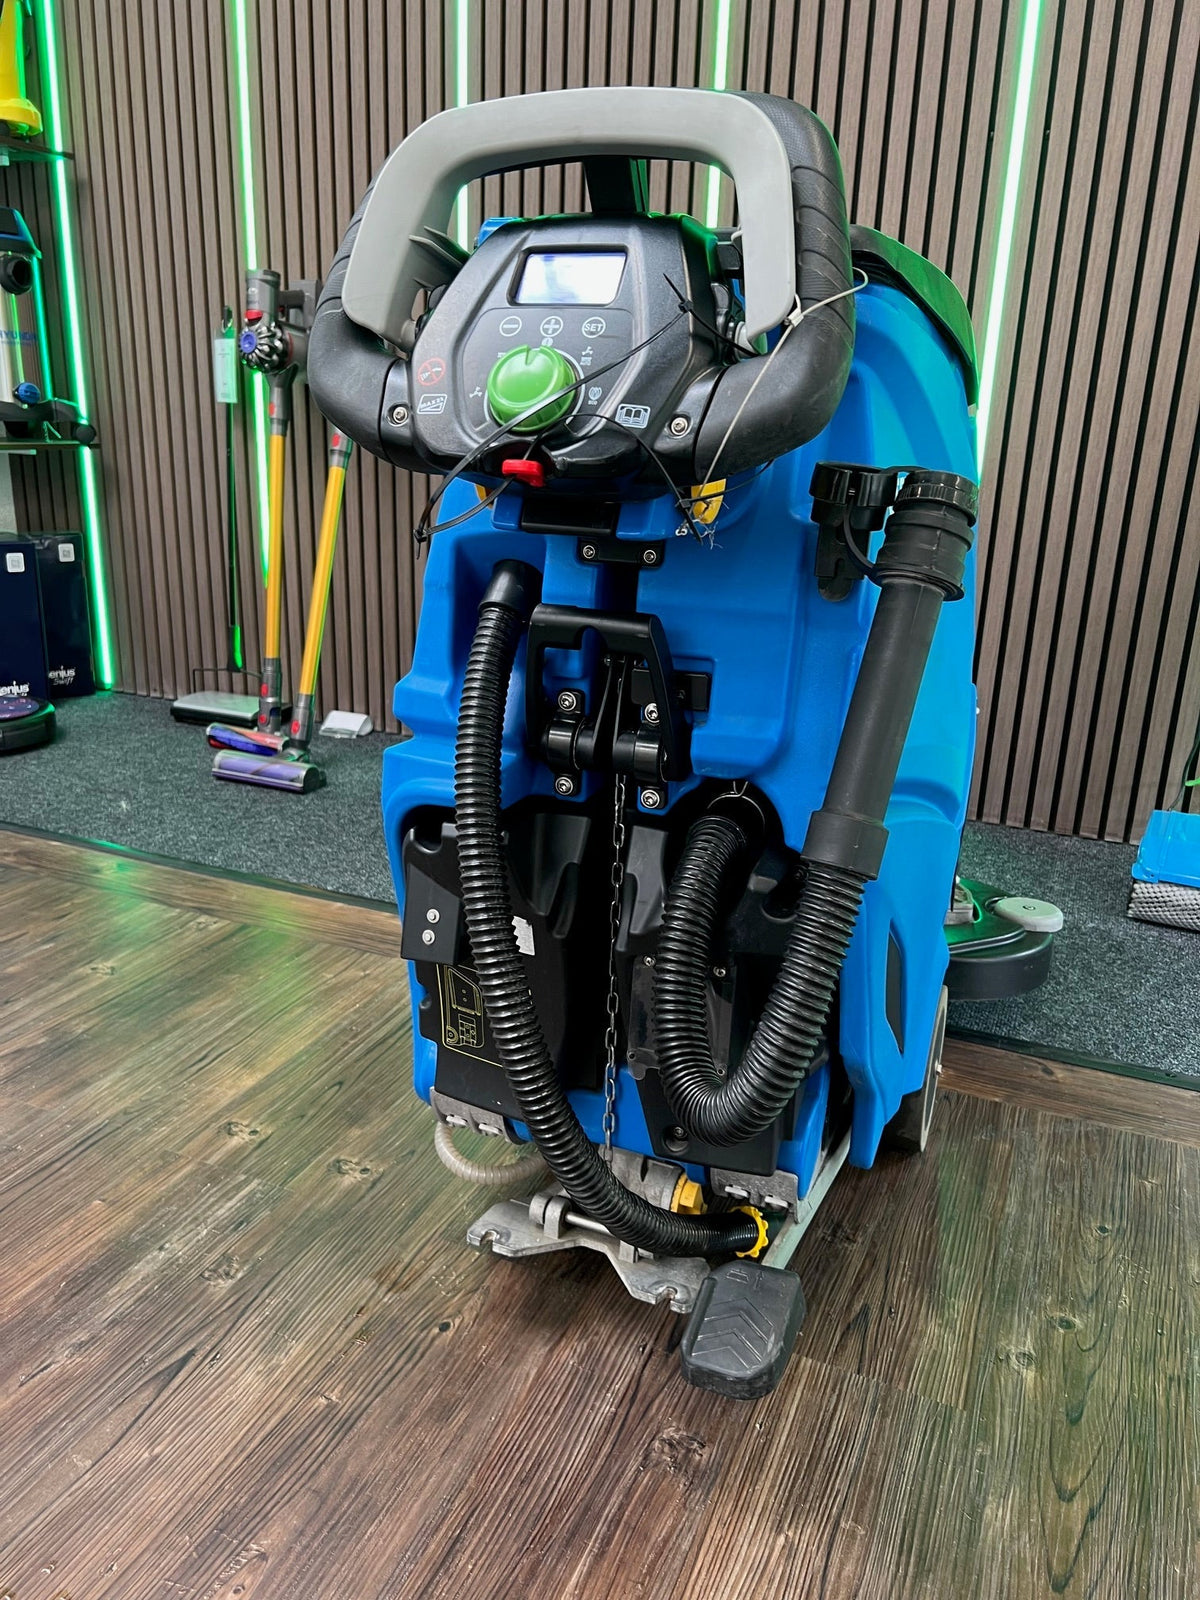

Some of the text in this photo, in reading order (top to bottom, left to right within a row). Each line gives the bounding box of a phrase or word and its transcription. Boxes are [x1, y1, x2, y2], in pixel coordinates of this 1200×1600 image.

[584, 323, 603, 332] SET
[48, 665, 76, 679] enius
[0, 680, 30, 697] enius
